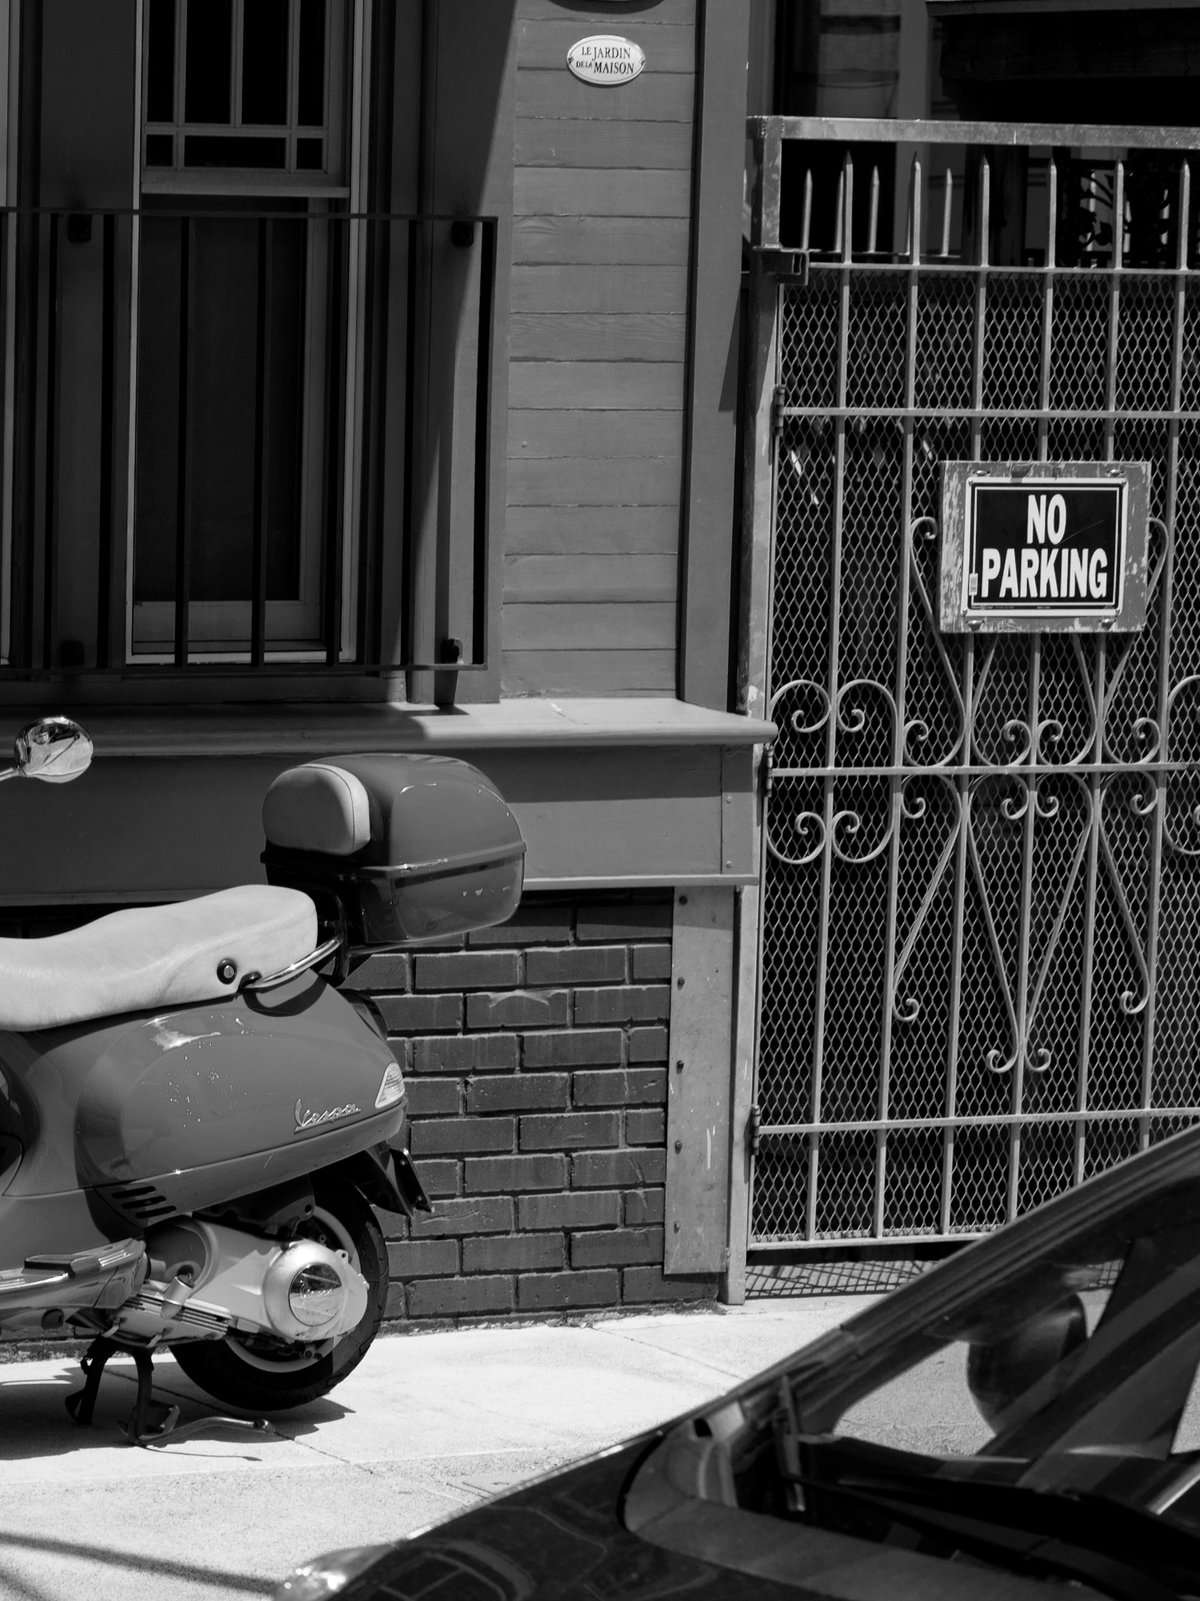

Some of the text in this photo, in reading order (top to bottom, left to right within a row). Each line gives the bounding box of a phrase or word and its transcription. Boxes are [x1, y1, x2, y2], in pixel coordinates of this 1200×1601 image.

[582, 47, 630, 60] LE JARDIN
[594, 62, 634, 74] MAISON
[1027, 494, 1066, 545] NO
[981, 548, 1108, 598] PARKING
